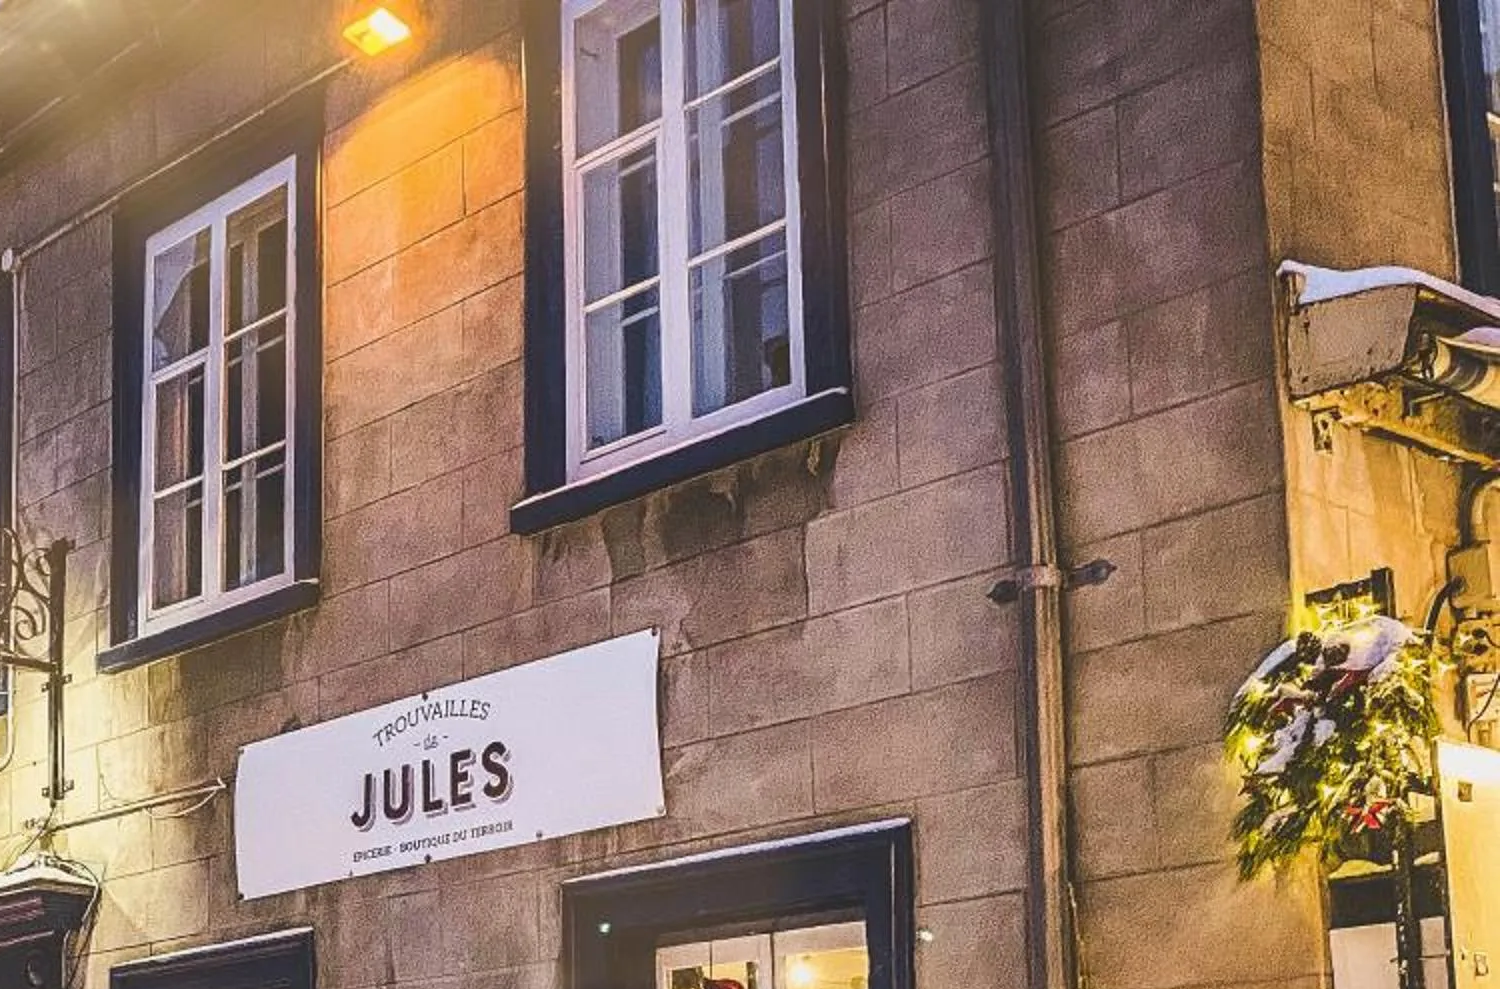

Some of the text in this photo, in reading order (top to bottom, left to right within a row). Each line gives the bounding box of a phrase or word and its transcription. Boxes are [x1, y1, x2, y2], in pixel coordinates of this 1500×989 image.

[372, 699, 491, 747] TROUVAILLES
[350, 741, 514, 831] JULES
[399, 833, 450, 853] BOUTIQUE
[452, 829, 467, 842] DU
